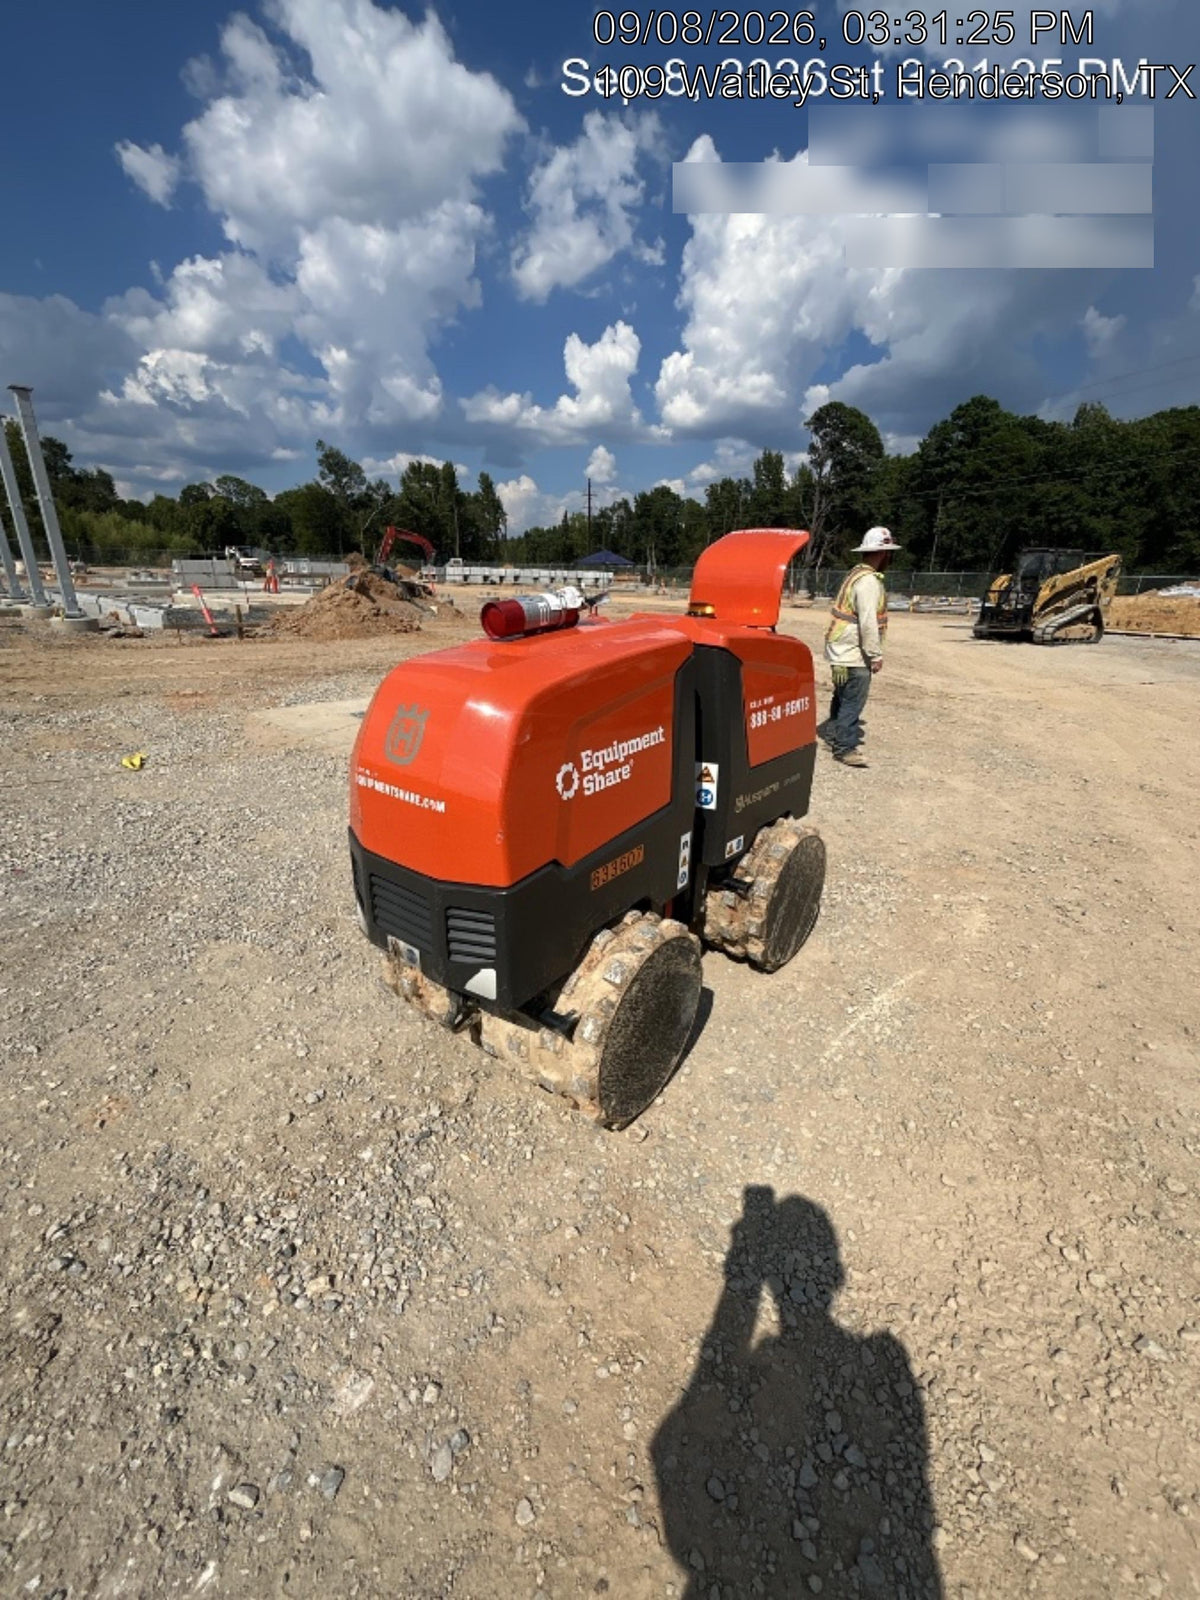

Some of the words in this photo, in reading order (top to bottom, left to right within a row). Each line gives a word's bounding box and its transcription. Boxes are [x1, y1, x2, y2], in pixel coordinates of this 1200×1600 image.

[580, 725, 665, 772] Equipment
[355, 772, 446, 814] IPMENTSHARE.COM
[582, 764, 631, 796] Share
